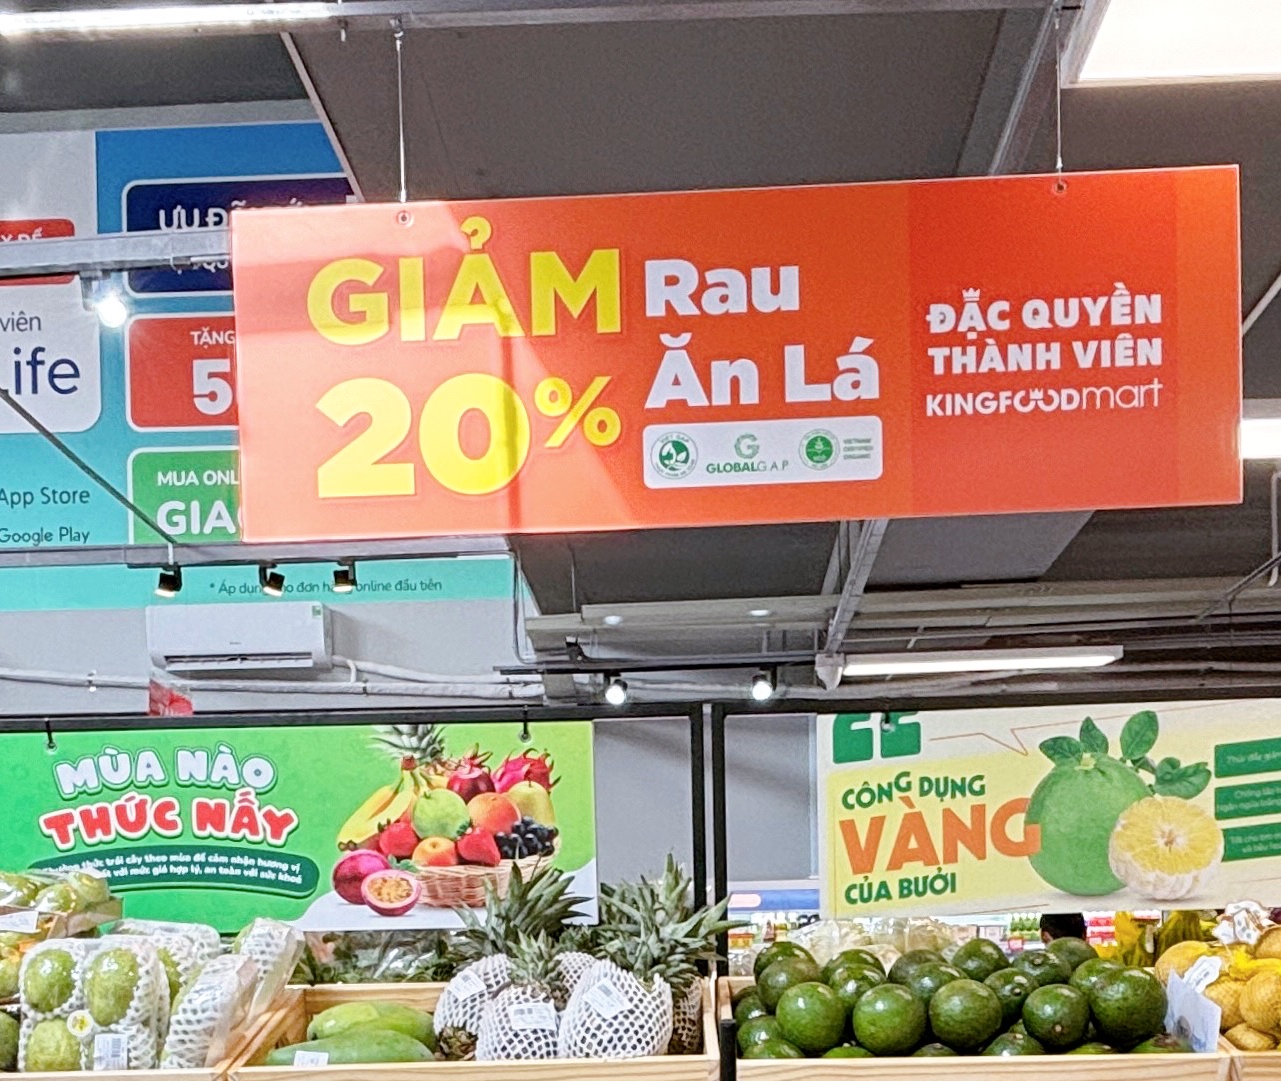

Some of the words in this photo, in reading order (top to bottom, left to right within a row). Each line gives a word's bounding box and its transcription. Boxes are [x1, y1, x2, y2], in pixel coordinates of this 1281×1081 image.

[307, 216, 622, 346] GIẢM
[645, 259, 800, 317] Rau
[1, 313, 42, 334] viên
[926, 288, 1011, 339] ĐẶC
[1023, 282, 1163, 329] QUYỀN
[644, 332, 760, 410] Ăn
[784, 337, 880, 403] Lá
[927, 334, 1061, 378] THÀNH
[1073, 333, 1163, 370] VIÊN
[926, 379, 1163, 418] KINGFOODmart
[315, 373, 622, 499] 20%
[41, 486, 90, 505] Store
[157, 471, 202, 487] MUA
[204, 469, 240, 487] ONL
[57, 526, 90, 544] Play
[157, 500, 239, 536] GIA
[219, 579, 236, 595] Áp
[239, 581, 264, 597] dụn
[296, 580, 320, 593] đơn
[355, 579, 392, 594] online
[394, 578, 417, 593] đầu
[420, 579, 442, 591] tiên
[54, 746, 166, 799] MÙA
[176, 743, 277, 794] NÀO
[841, 771, 913, 810] CÔNG
[918, 774, 987, 803] DỤNG
[39, 792, 184, 850] THỨC
[191, 786, 299, 849] NẤY
[839, 795, 1042, 876] VÀNG
[844, 875, 893, 905] CỦA
[898, 867, 957, 900] BƯỞI
